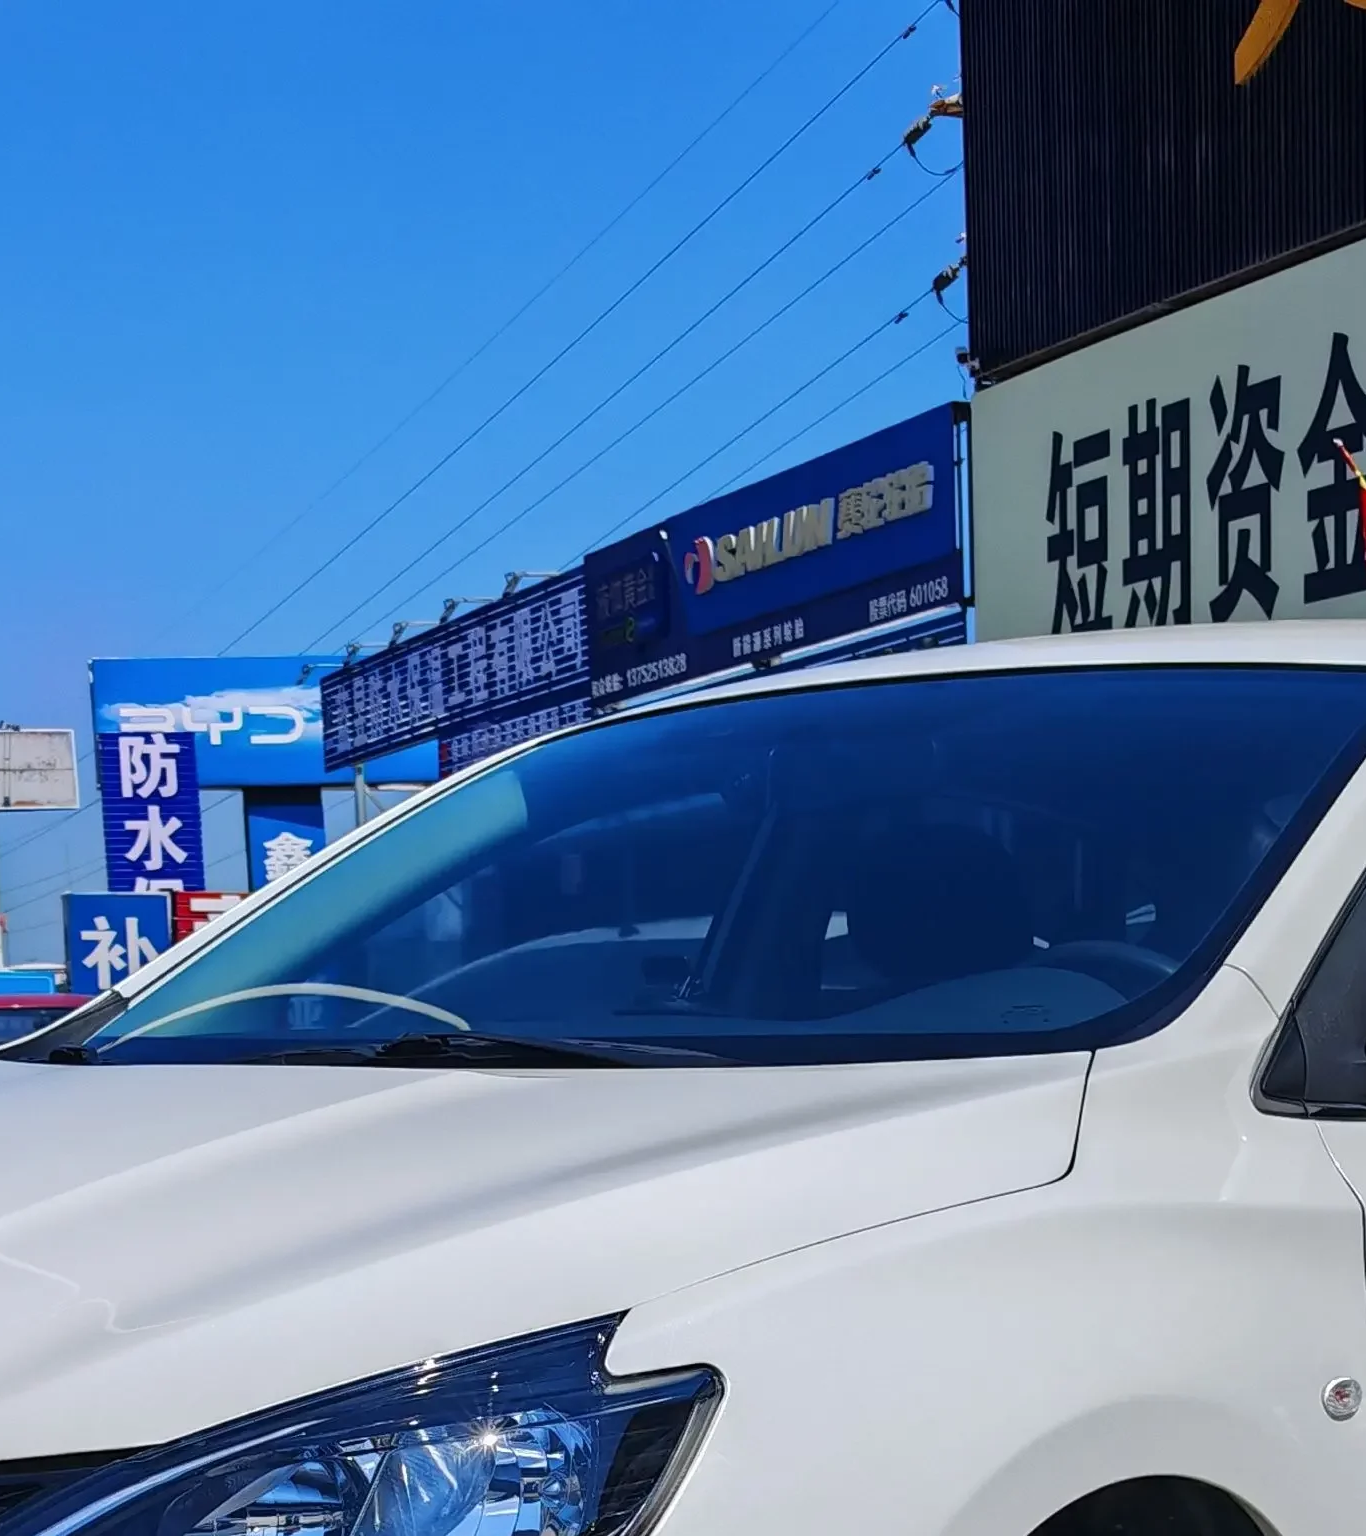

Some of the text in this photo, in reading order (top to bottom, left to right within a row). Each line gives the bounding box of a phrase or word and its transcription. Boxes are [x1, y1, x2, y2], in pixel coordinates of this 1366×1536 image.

[714, 497, 835, 582] SAILUN
[909, 575, 949, 608] 601058
[119, 705, 304, 745] BYD
[117, 732, 188, 892] 防水
